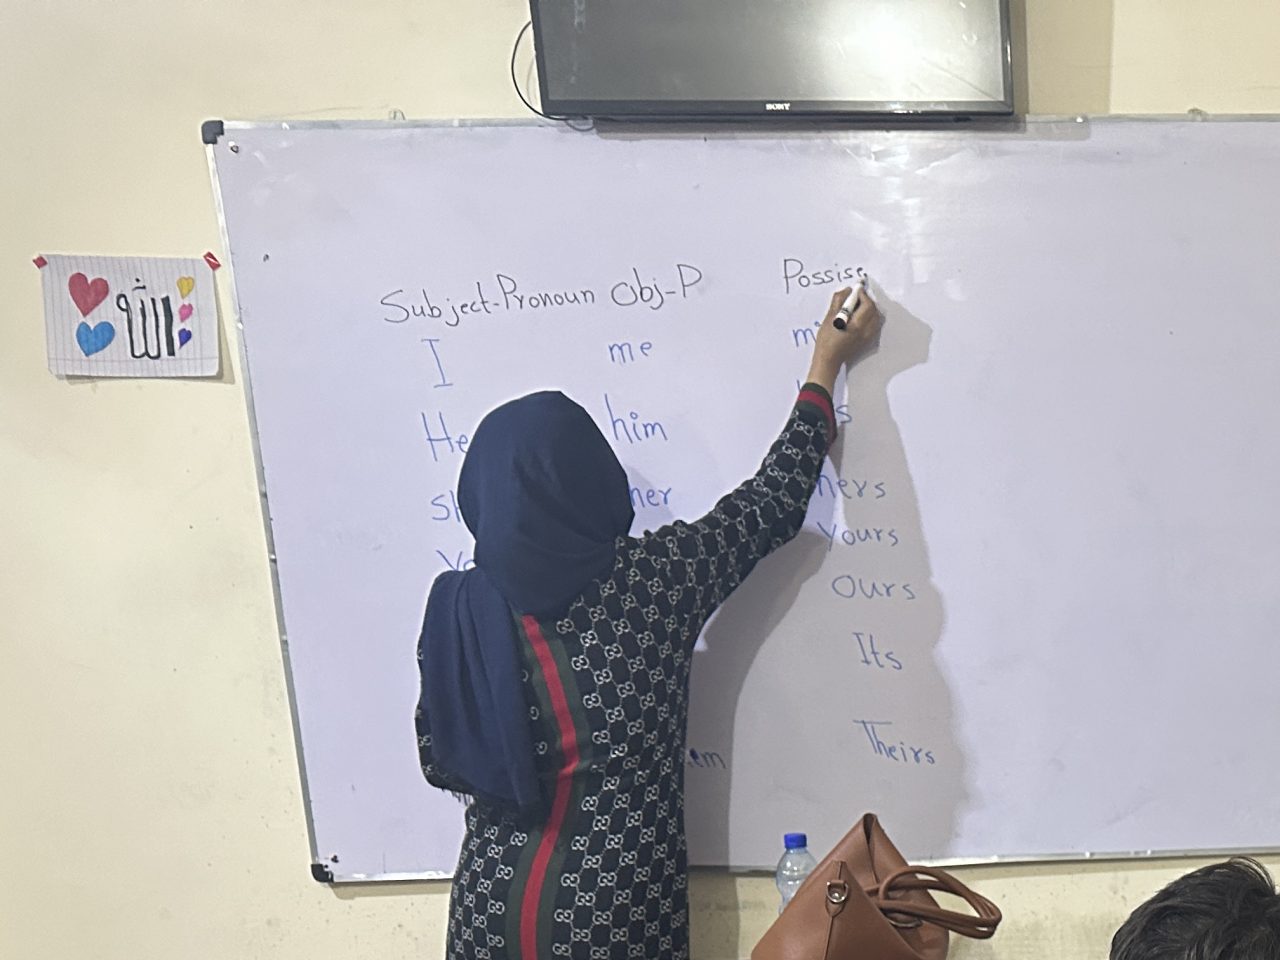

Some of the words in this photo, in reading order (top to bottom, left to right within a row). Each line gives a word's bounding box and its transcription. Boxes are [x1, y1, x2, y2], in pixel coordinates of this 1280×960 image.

[765, 102, 791, 111] SONY
[421, 337, 453, 388] I
[608, 341, 653, 364] me
[421, 410, 470, 463] He
[604, 393, 669, 444] him
[831, 574, 916, 600] Ours
[851, 631, 903, 671] Its
[852, 719, 936, 765] Theirs
